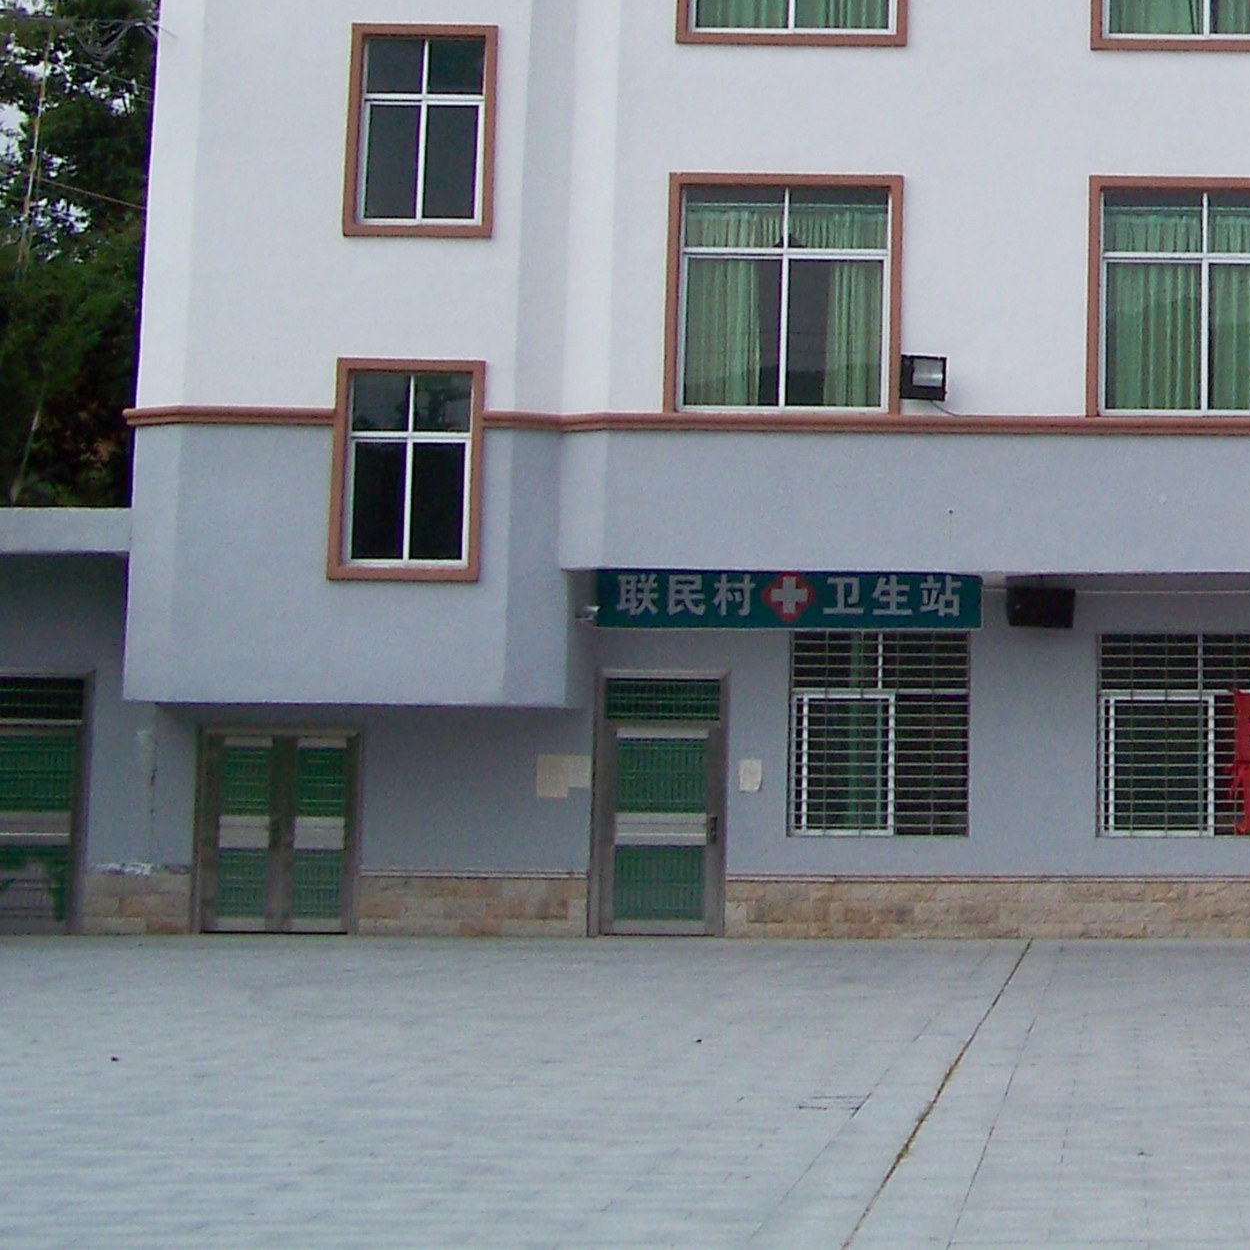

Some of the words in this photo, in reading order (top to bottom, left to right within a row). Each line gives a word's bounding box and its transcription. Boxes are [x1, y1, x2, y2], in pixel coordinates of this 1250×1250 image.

[615, 573, 756, 617] 联民村
[822, 574, 963, 617] 卫生站
